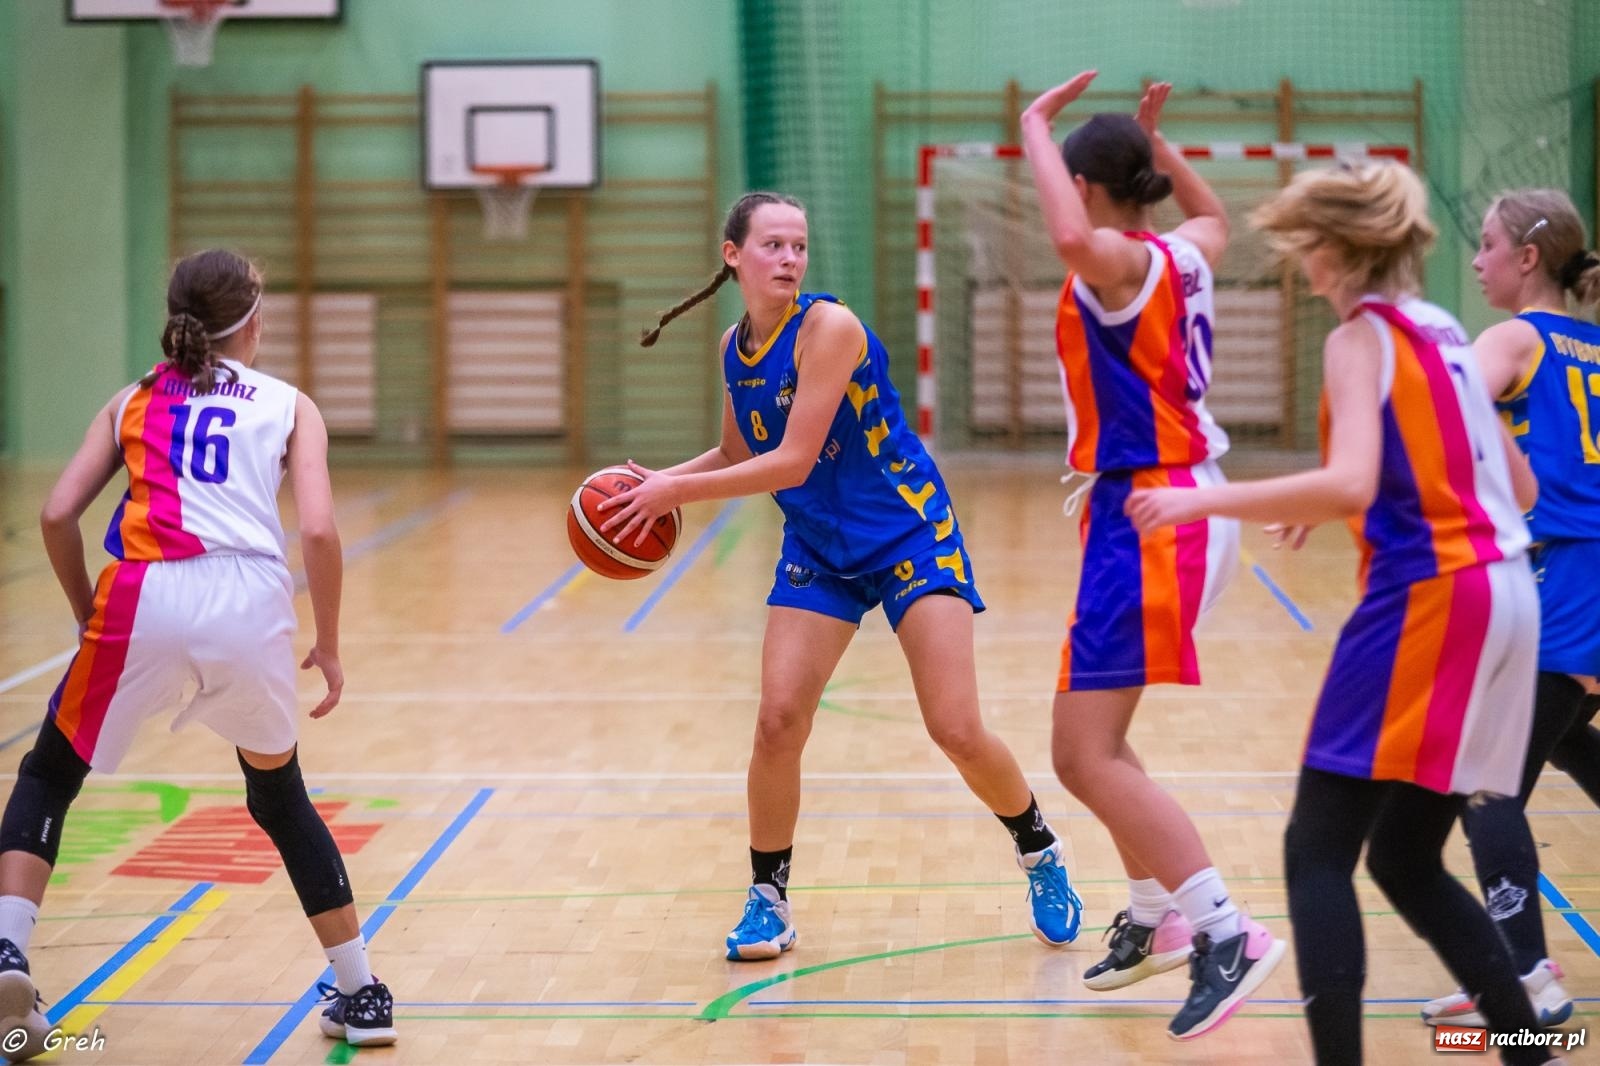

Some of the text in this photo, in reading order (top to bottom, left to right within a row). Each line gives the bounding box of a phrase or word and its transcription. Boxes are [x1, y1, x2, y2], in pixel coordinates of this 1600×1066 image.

[163, 378, 257, 402] RACBORZ
[751, 410, 768, 441] 8
[168, 404, 236, 484] 16
